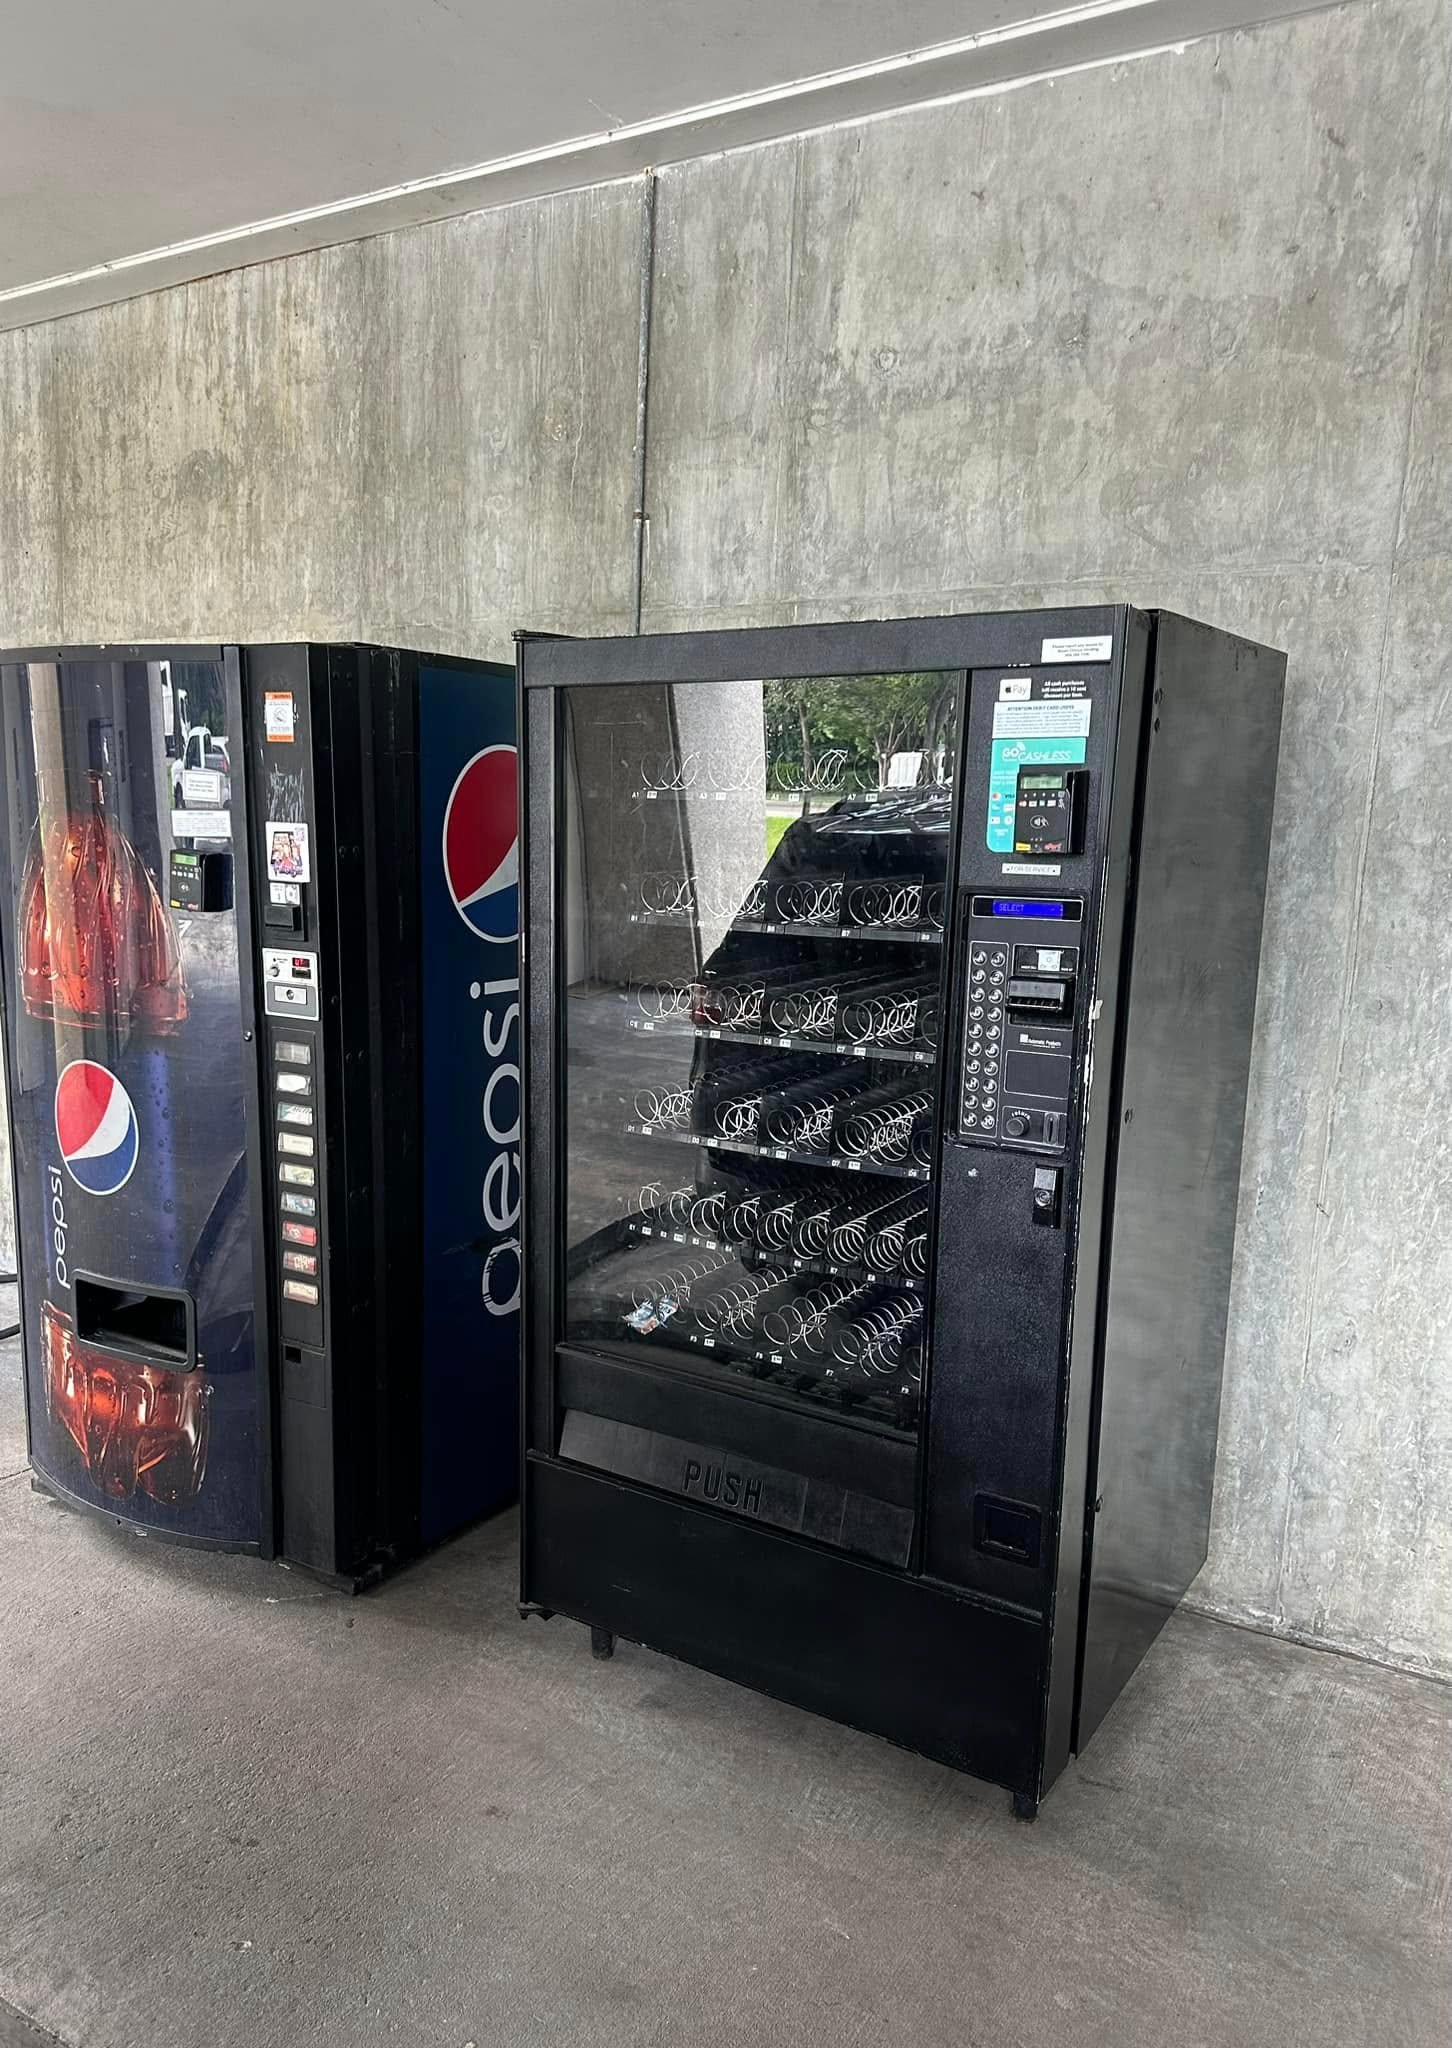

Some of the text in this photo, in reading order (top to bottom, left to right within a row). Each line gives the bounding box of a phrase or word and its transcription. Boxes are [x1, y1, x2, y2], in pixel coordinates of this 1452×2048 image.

[1013, 685, 1027, 695] Pay
[1018, 750, 1072, 761] CASHLESS
[999, 903, 1025, 912] SELECT
[1011, 1110, 1031, 1120] return
[470, 978, 521, 1316] pepsi
[48, 1165, 71, 1290] pepsi
[681, 1459, 765, 1515] PUSH
